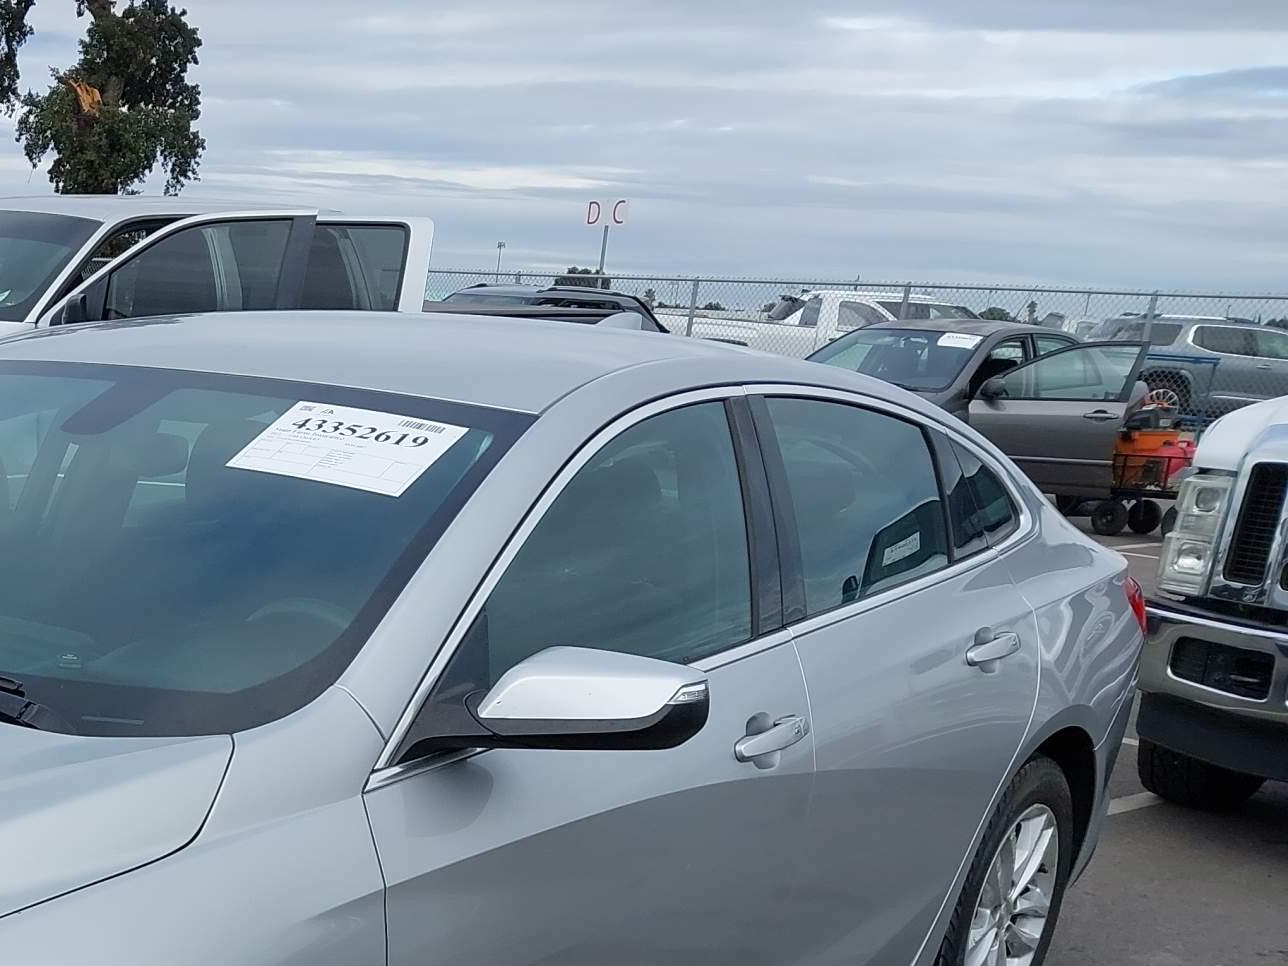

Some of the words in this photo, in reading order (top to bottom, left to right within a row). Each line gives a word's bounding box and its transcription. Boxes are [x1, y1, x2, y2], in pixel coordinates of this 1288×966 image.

[587, 201, 601, 225] D
[612, 200, 626, 224] C
[292, 417, 429, 448] 43352619
